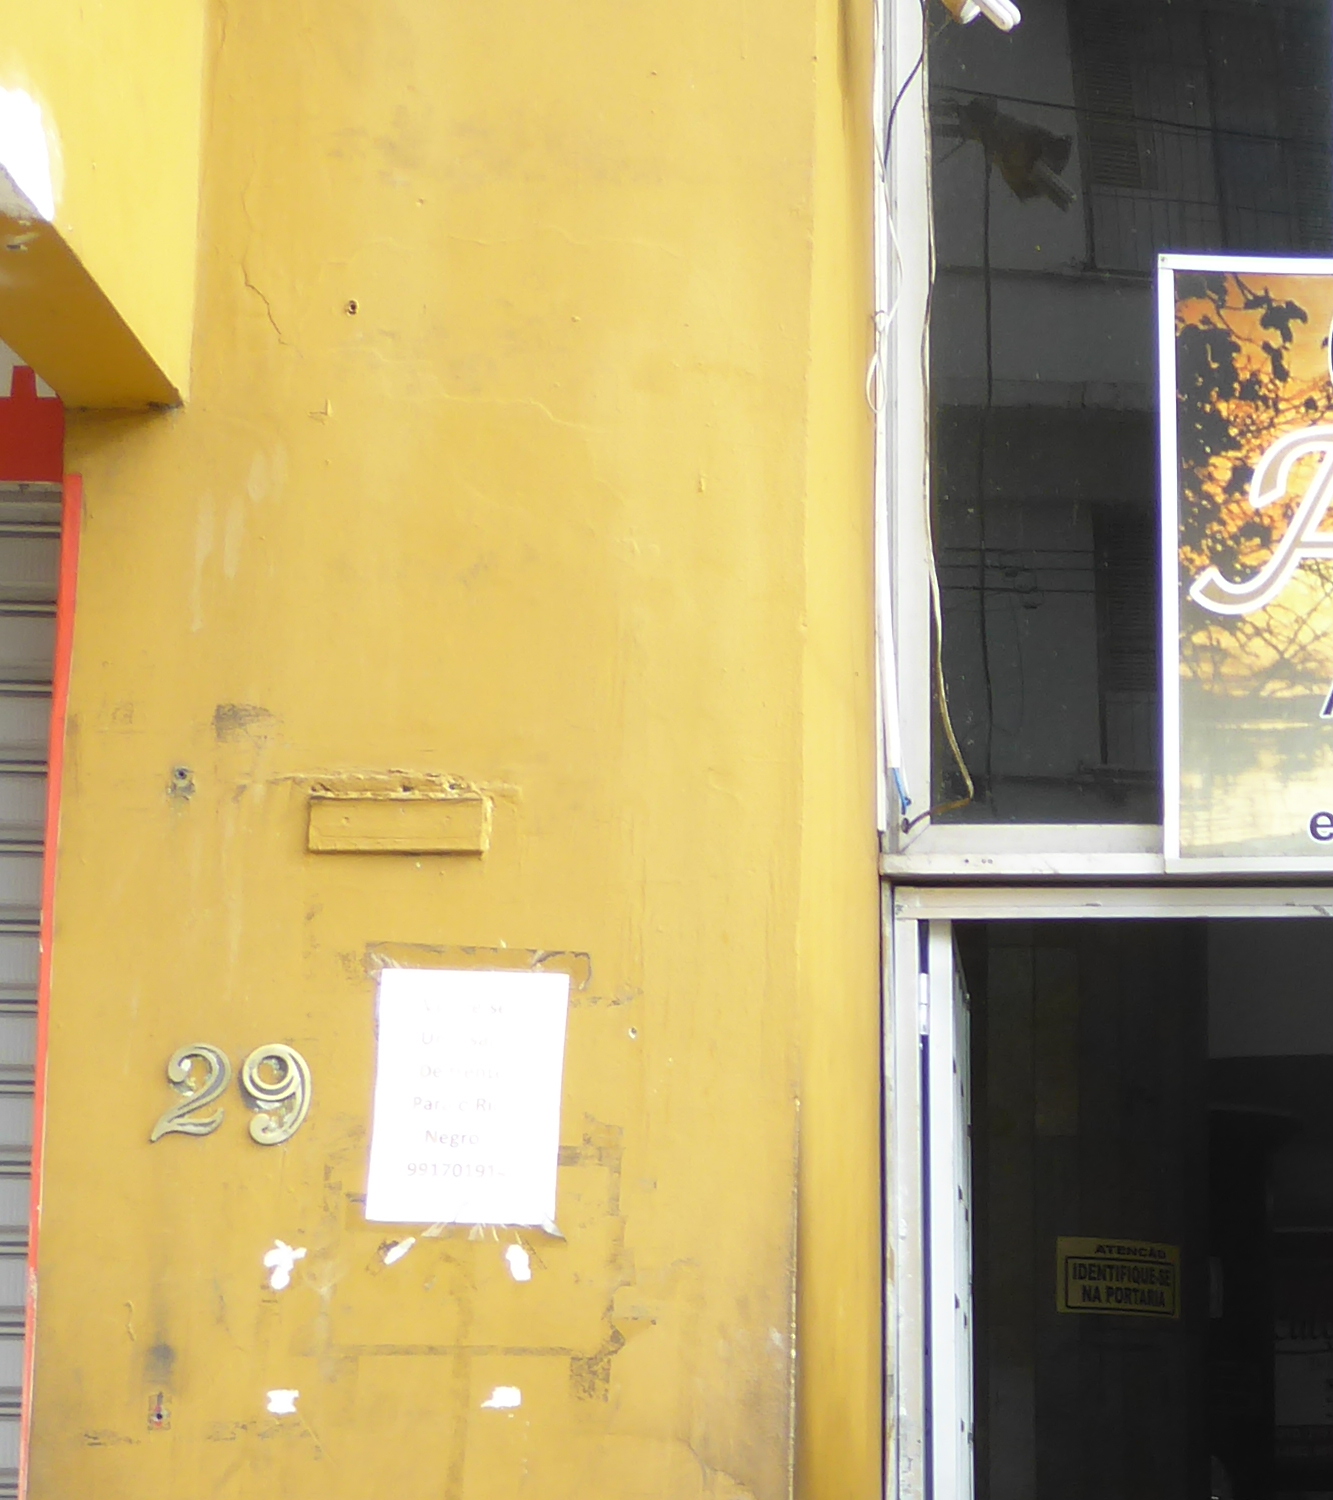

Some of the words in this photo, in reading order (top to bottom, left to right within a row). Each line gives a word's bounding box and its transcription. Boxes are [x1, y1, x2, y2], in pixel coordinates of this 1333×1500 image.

[150, 1042, 312, 1146] 29
[424, 1128, 481, 1149] Negro
[1082, 1284, 1102, 1303] NA
[1106, 1285, 1166, 1307] PORTARIA
